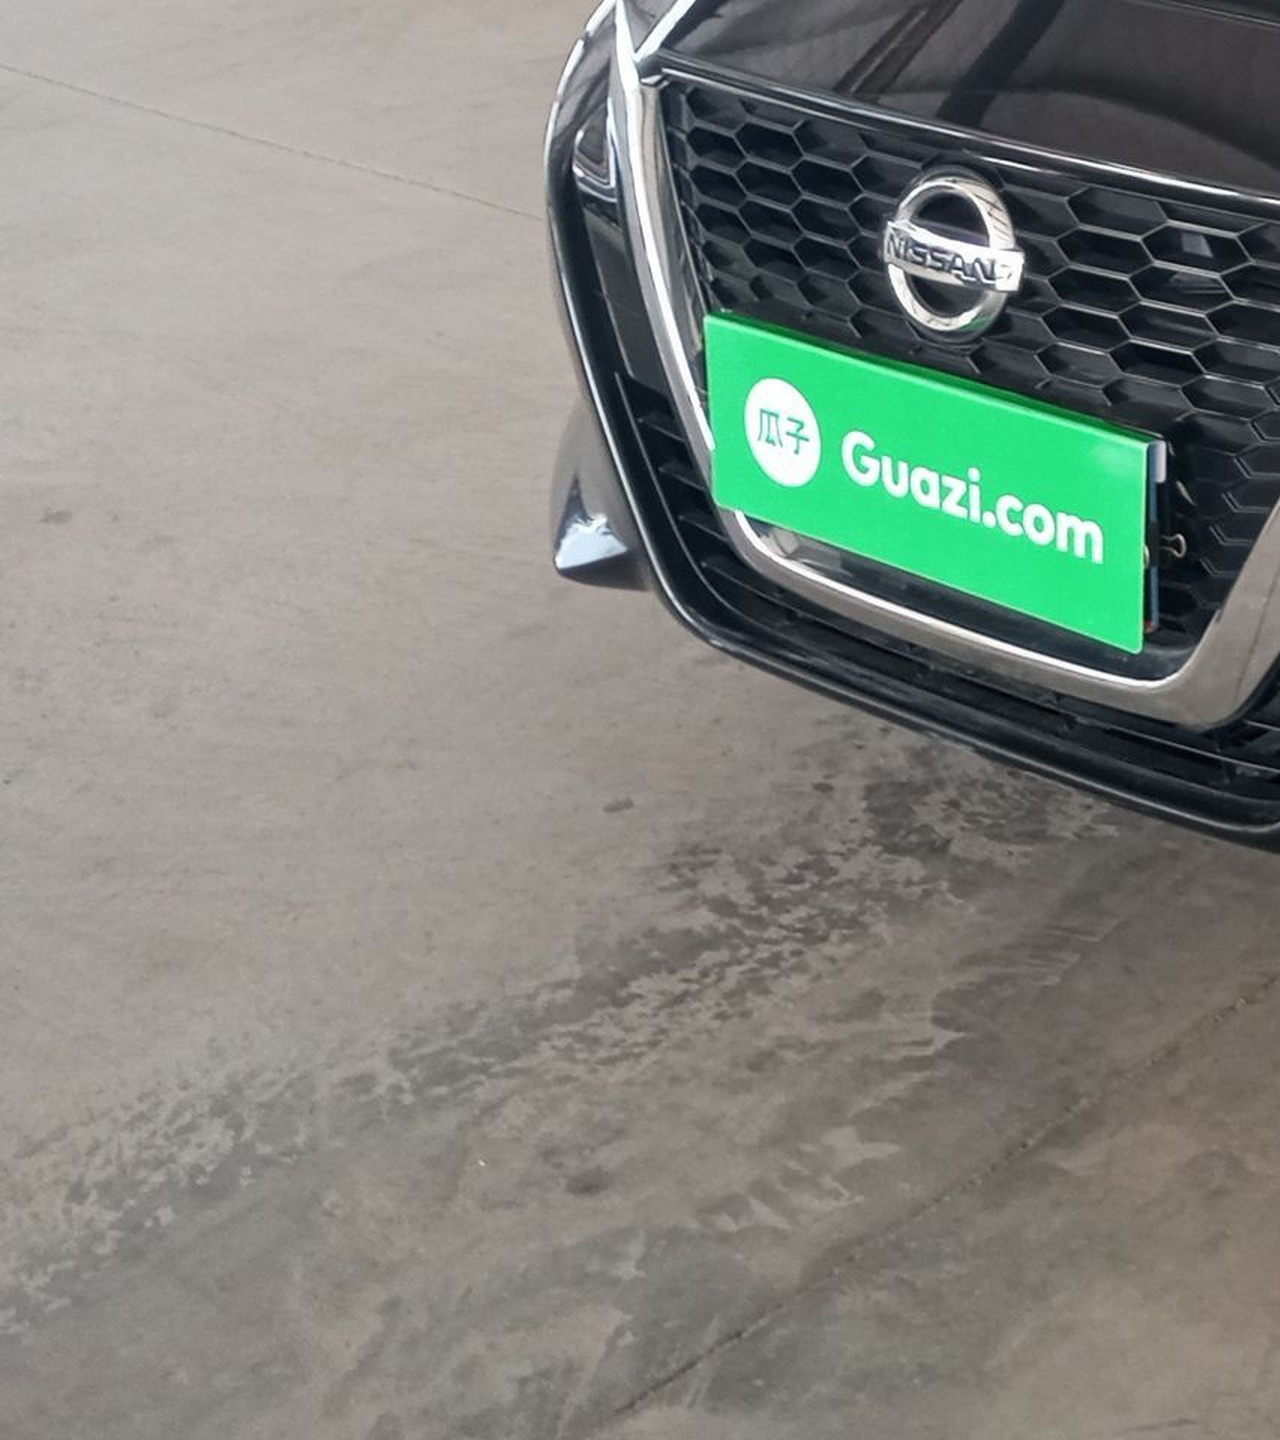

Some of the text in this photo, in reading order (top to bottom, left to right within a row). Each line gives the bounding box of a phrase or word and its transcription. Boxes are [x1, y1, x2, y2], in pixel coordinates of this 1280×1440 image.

[885, 222, 998, 288] NISSAN
[756, 407, 811, 457] 瓜子
[839, 429, 1104, 564] Guazi.com
